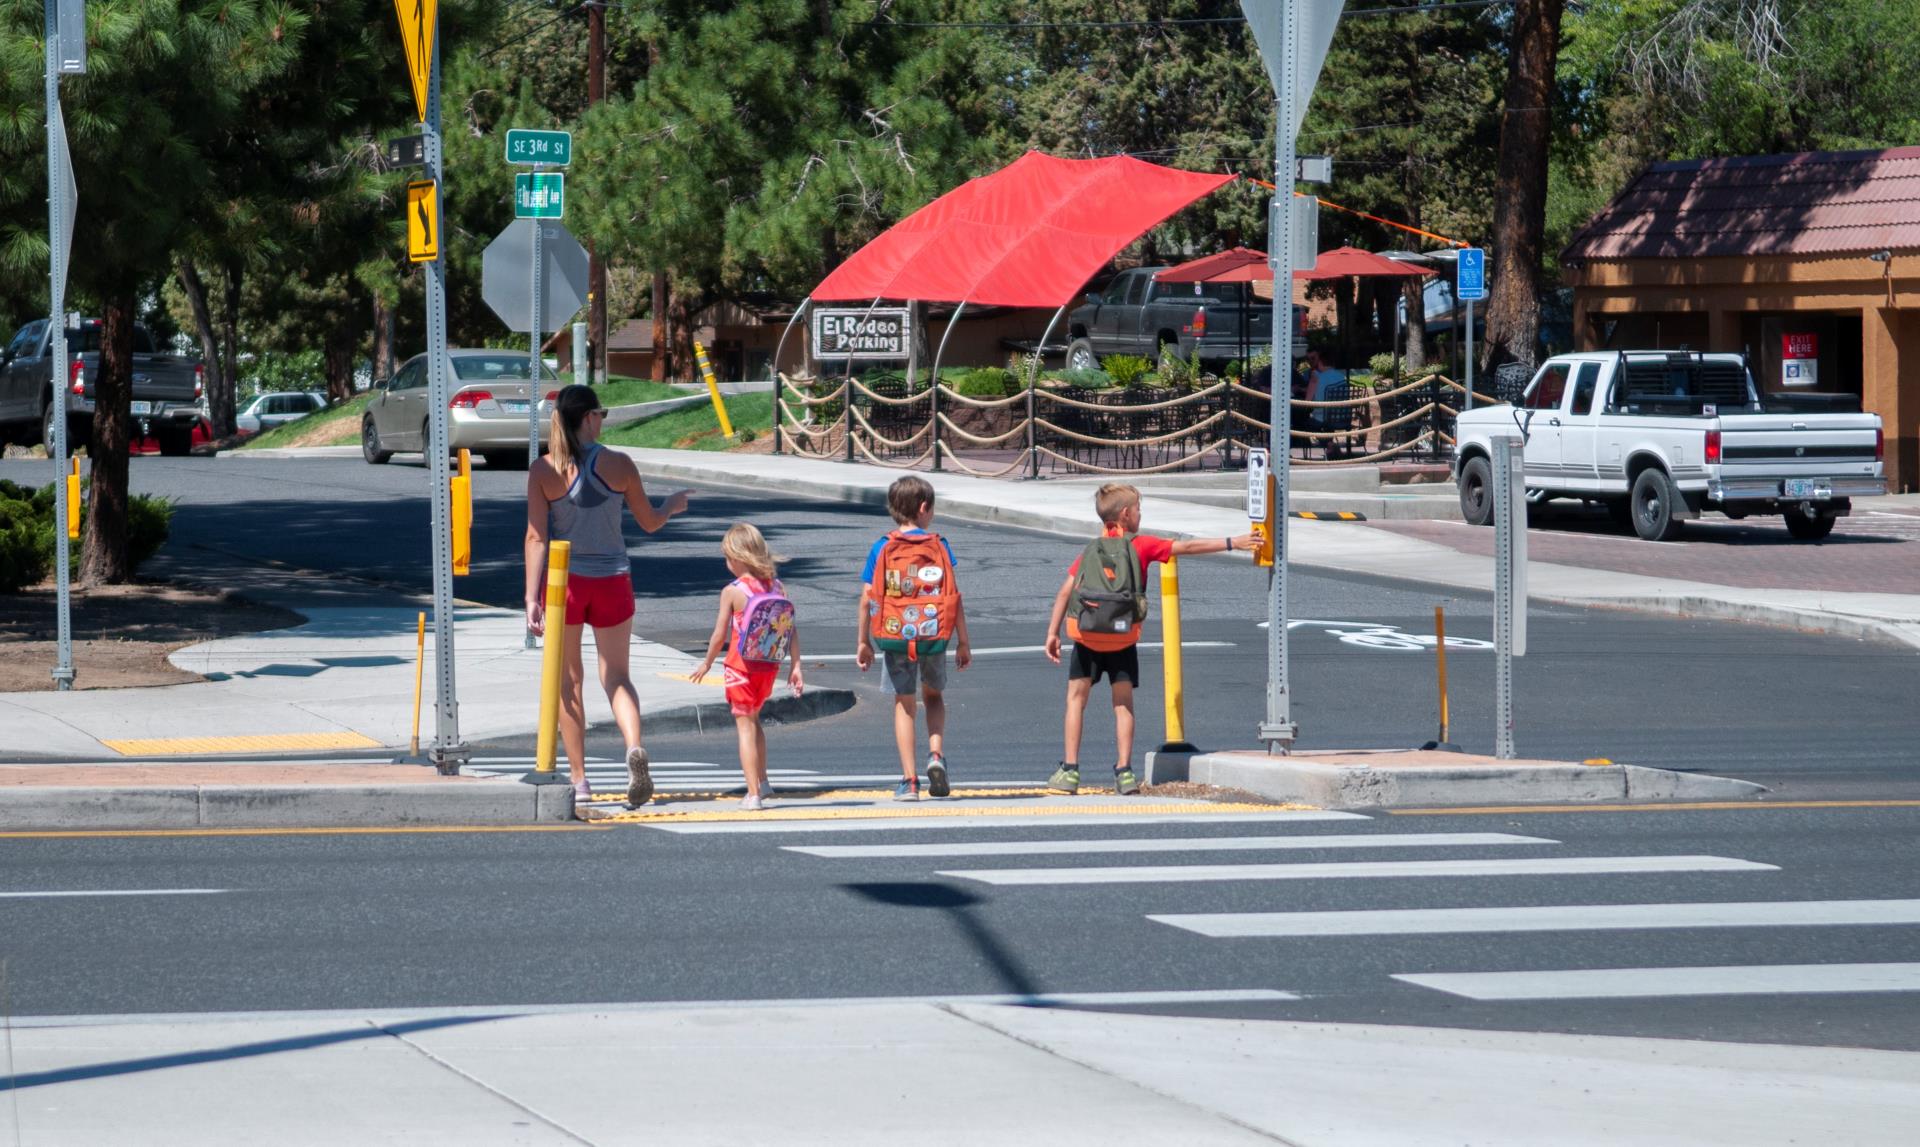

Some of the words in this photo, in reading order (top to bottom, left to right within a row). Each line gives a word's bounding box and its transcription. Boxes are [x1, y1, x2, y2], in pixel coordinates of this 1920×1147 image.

[514, 140, 526, 153] SE
[554, 142, 563, 155] St
[823, 316, 840, 335] El
[844, 316, 897, 335] Rodeo
[836, 334, 899, 352] Parking
[1788, 344, 1813, 353] HERE
